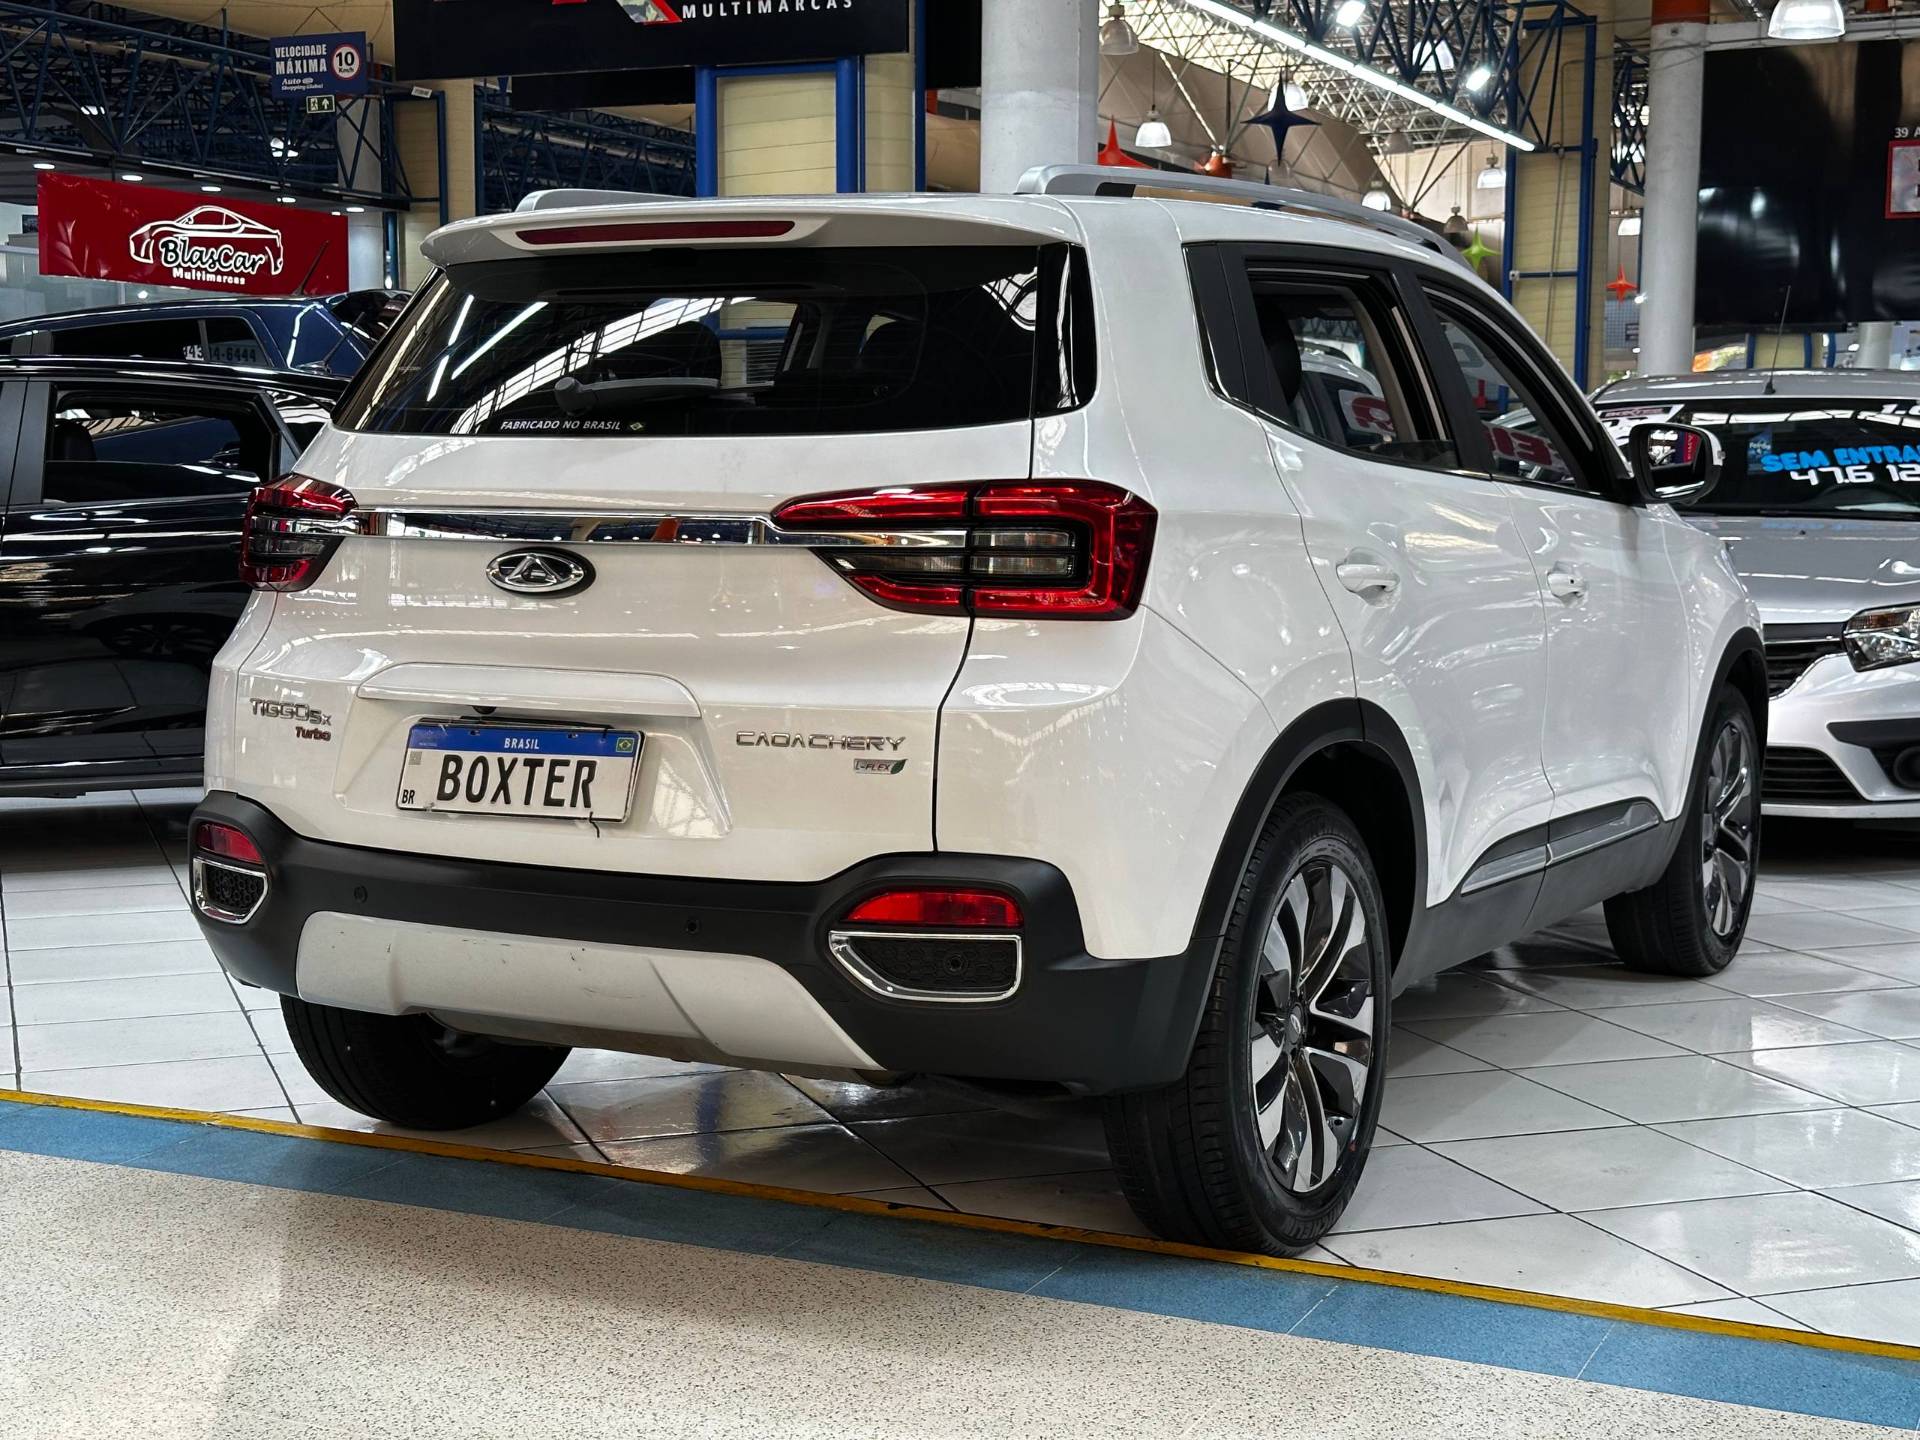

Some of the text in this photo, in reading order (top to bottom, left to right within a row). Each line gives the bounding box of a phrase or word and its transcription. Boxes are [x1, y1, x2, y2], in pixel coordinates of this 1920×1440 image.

[682, 0, 852, 19] MULTIMARCAS
[275, 44, 327, 58] VELOCIDADE
[335, 51, 355, 66] 10
[275, 58, 327, 75] MÁXIMA
[281, 78, 301, 86] Auto
[1894, 127, 1909, 138] 39
[159, 236, 266, 274] BlasCar
[172, 267, 246, 285] Multimarcas
[500, 420, 621, 430] FABRICADO NO BRASIL
[1760, 445, 1920, 472] SEM ENTRA
[295, 726, 331, 741] Turbo
[503, 737, 540, 750] BRASIL
[436, 754, 598, 809] BOXTER
[401, 789, 415, 805] BR
